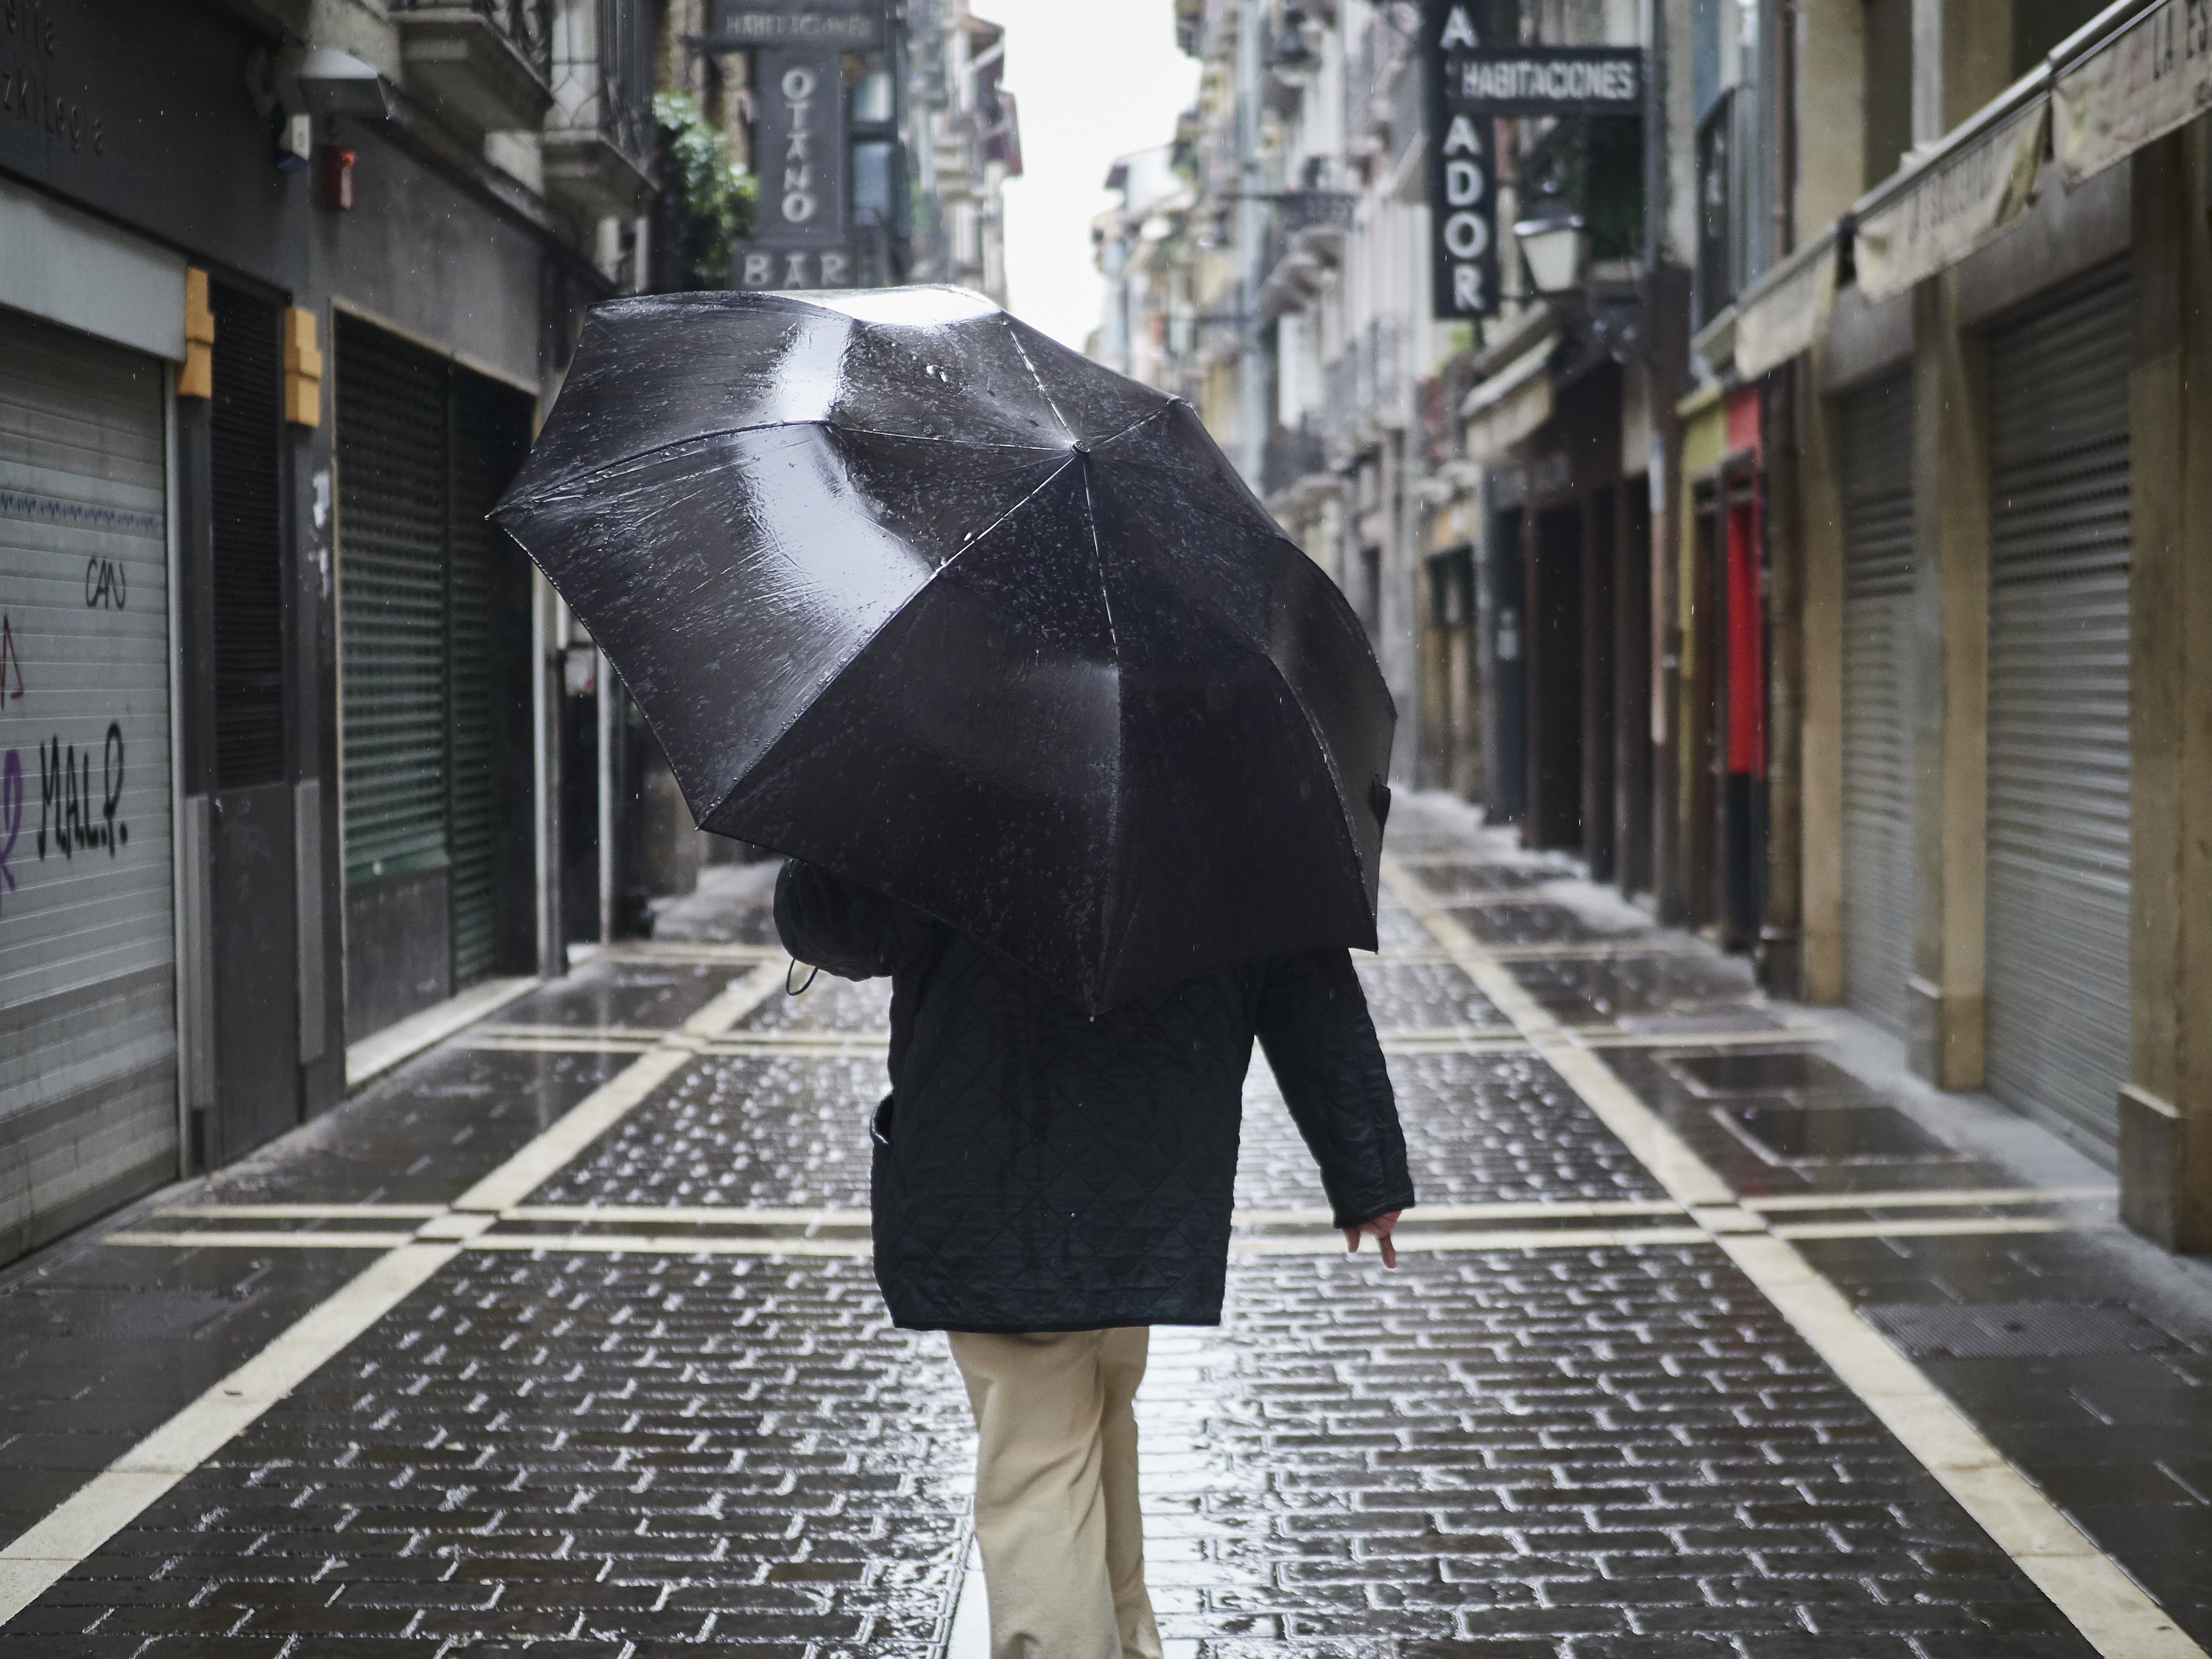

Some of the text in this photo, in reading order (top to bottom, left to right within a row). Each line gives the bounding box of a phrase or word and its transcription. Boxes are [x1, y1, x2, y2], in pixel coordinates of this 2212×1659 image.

[1462, 61, 1636, 100] HABITACIONES
[781, 67, 816, 223] OTANO
[1440, 5, 1489, 312] AADOR
[744, 250, 849, 290] BAR
